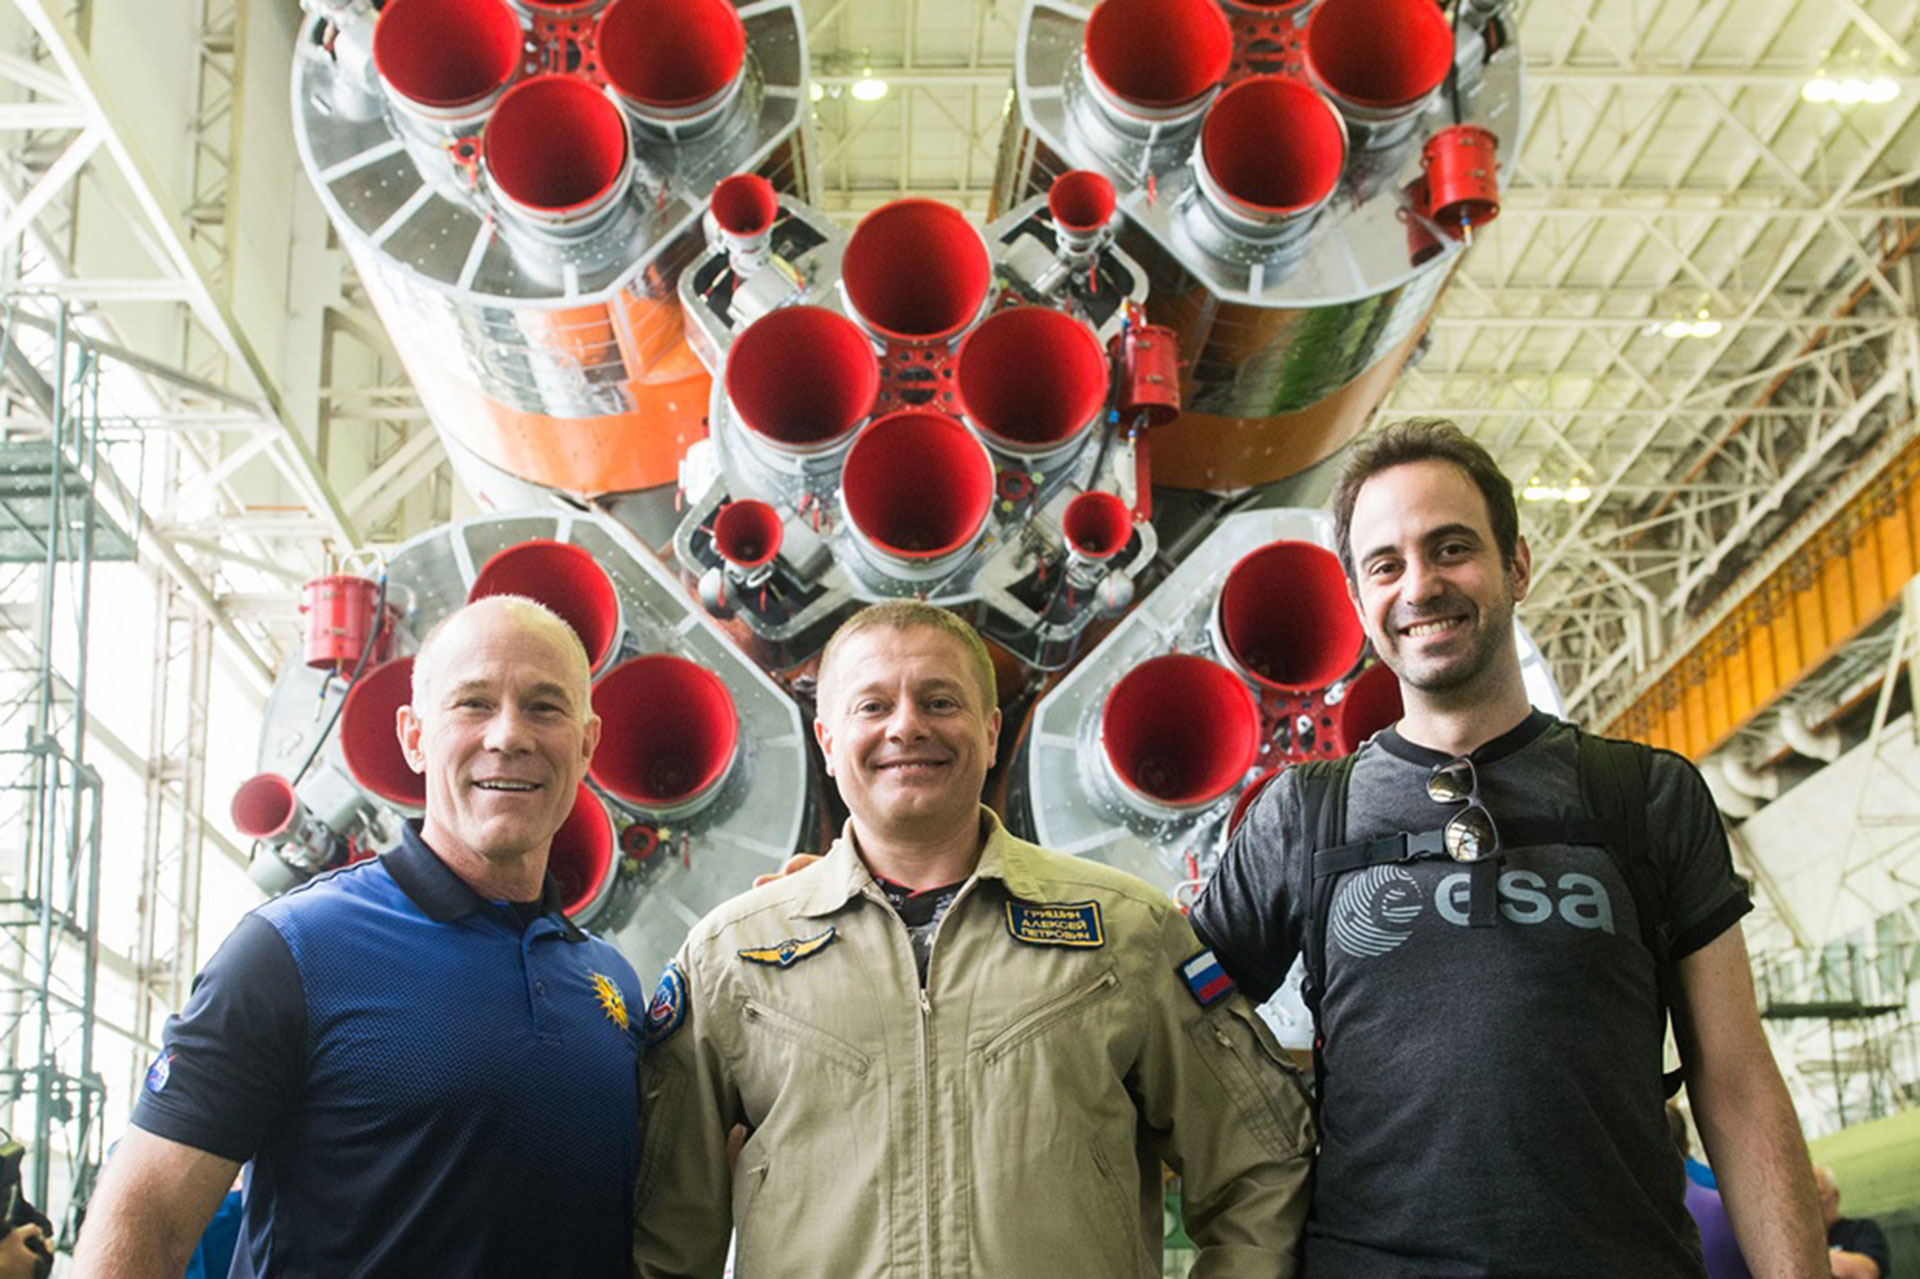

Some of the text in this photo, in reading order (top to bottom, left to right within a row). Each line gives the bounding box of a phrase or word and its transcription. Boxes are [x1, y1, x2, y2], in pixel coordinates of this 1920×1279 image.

[1434, 869, 1616, 935] esa
[1023, 909, 1081, 918] ГРИШИН
[1021, 919, 1087, 930] АЛЕКСЕЙ
[1021, 927, 1090, 939] ПЕТРОВИЧ
